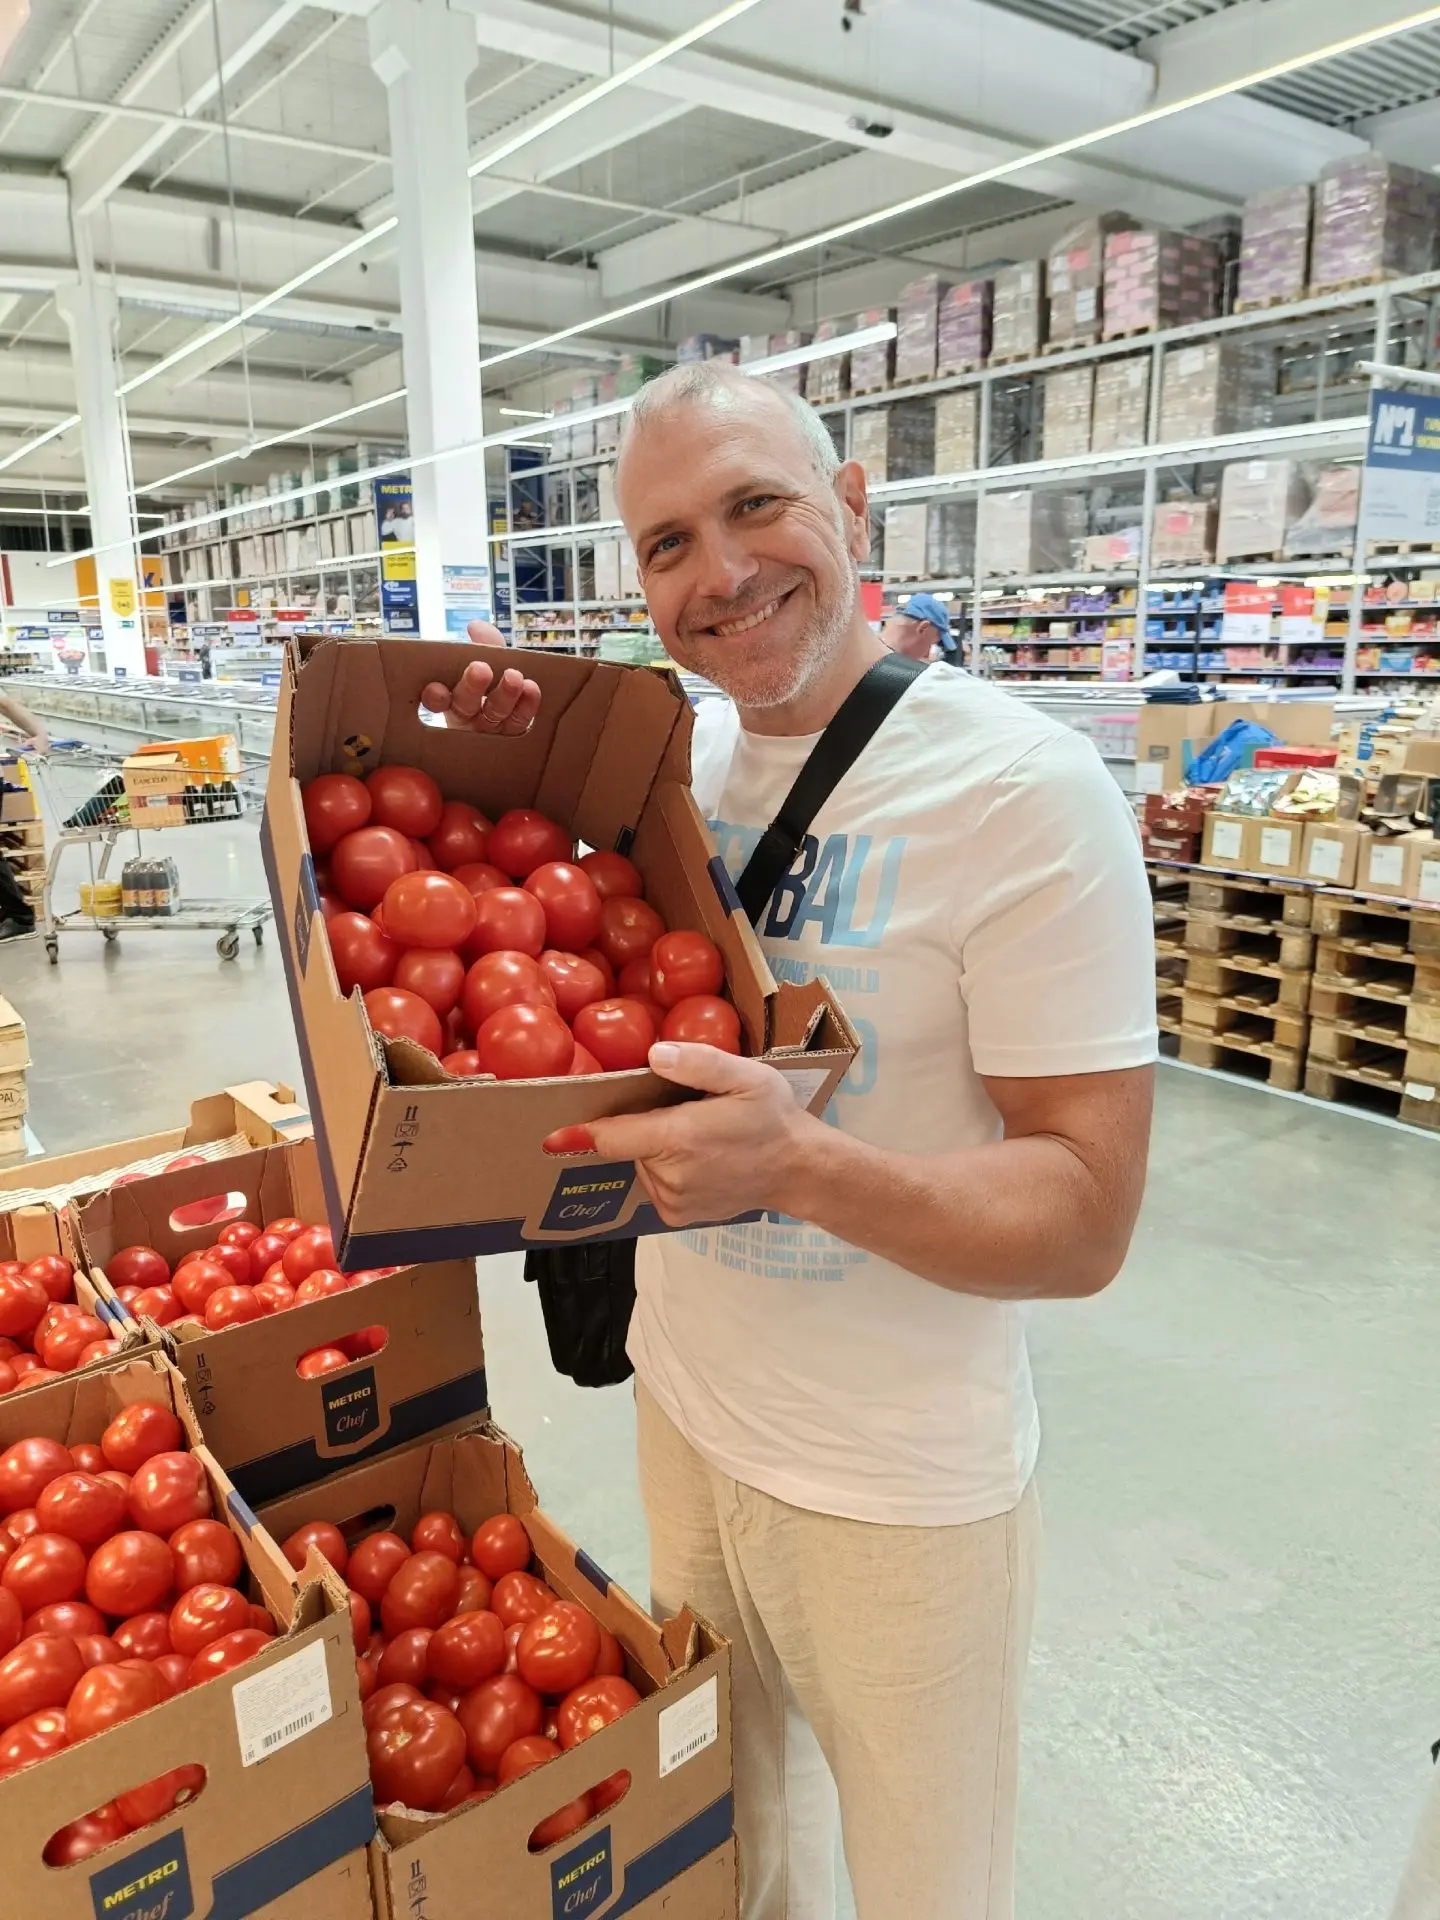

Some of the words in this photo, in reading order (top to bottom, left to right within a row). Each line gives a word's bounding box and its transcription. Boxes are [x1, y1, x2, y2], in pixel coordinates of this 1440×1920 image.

[381, 484, 413, 495] METR
[561, 1180, 626, 1196] METRO
[558, 1200, 611, 1219] Chef
[328, 1386, 371, 1410] METRO
[336, 1407, 369, 1432] Chef
[557, 1849, 606, 1890] METRO
[103, 1859, 179, 1910] METRO
[563, 1875, 602, 1913] Chef
